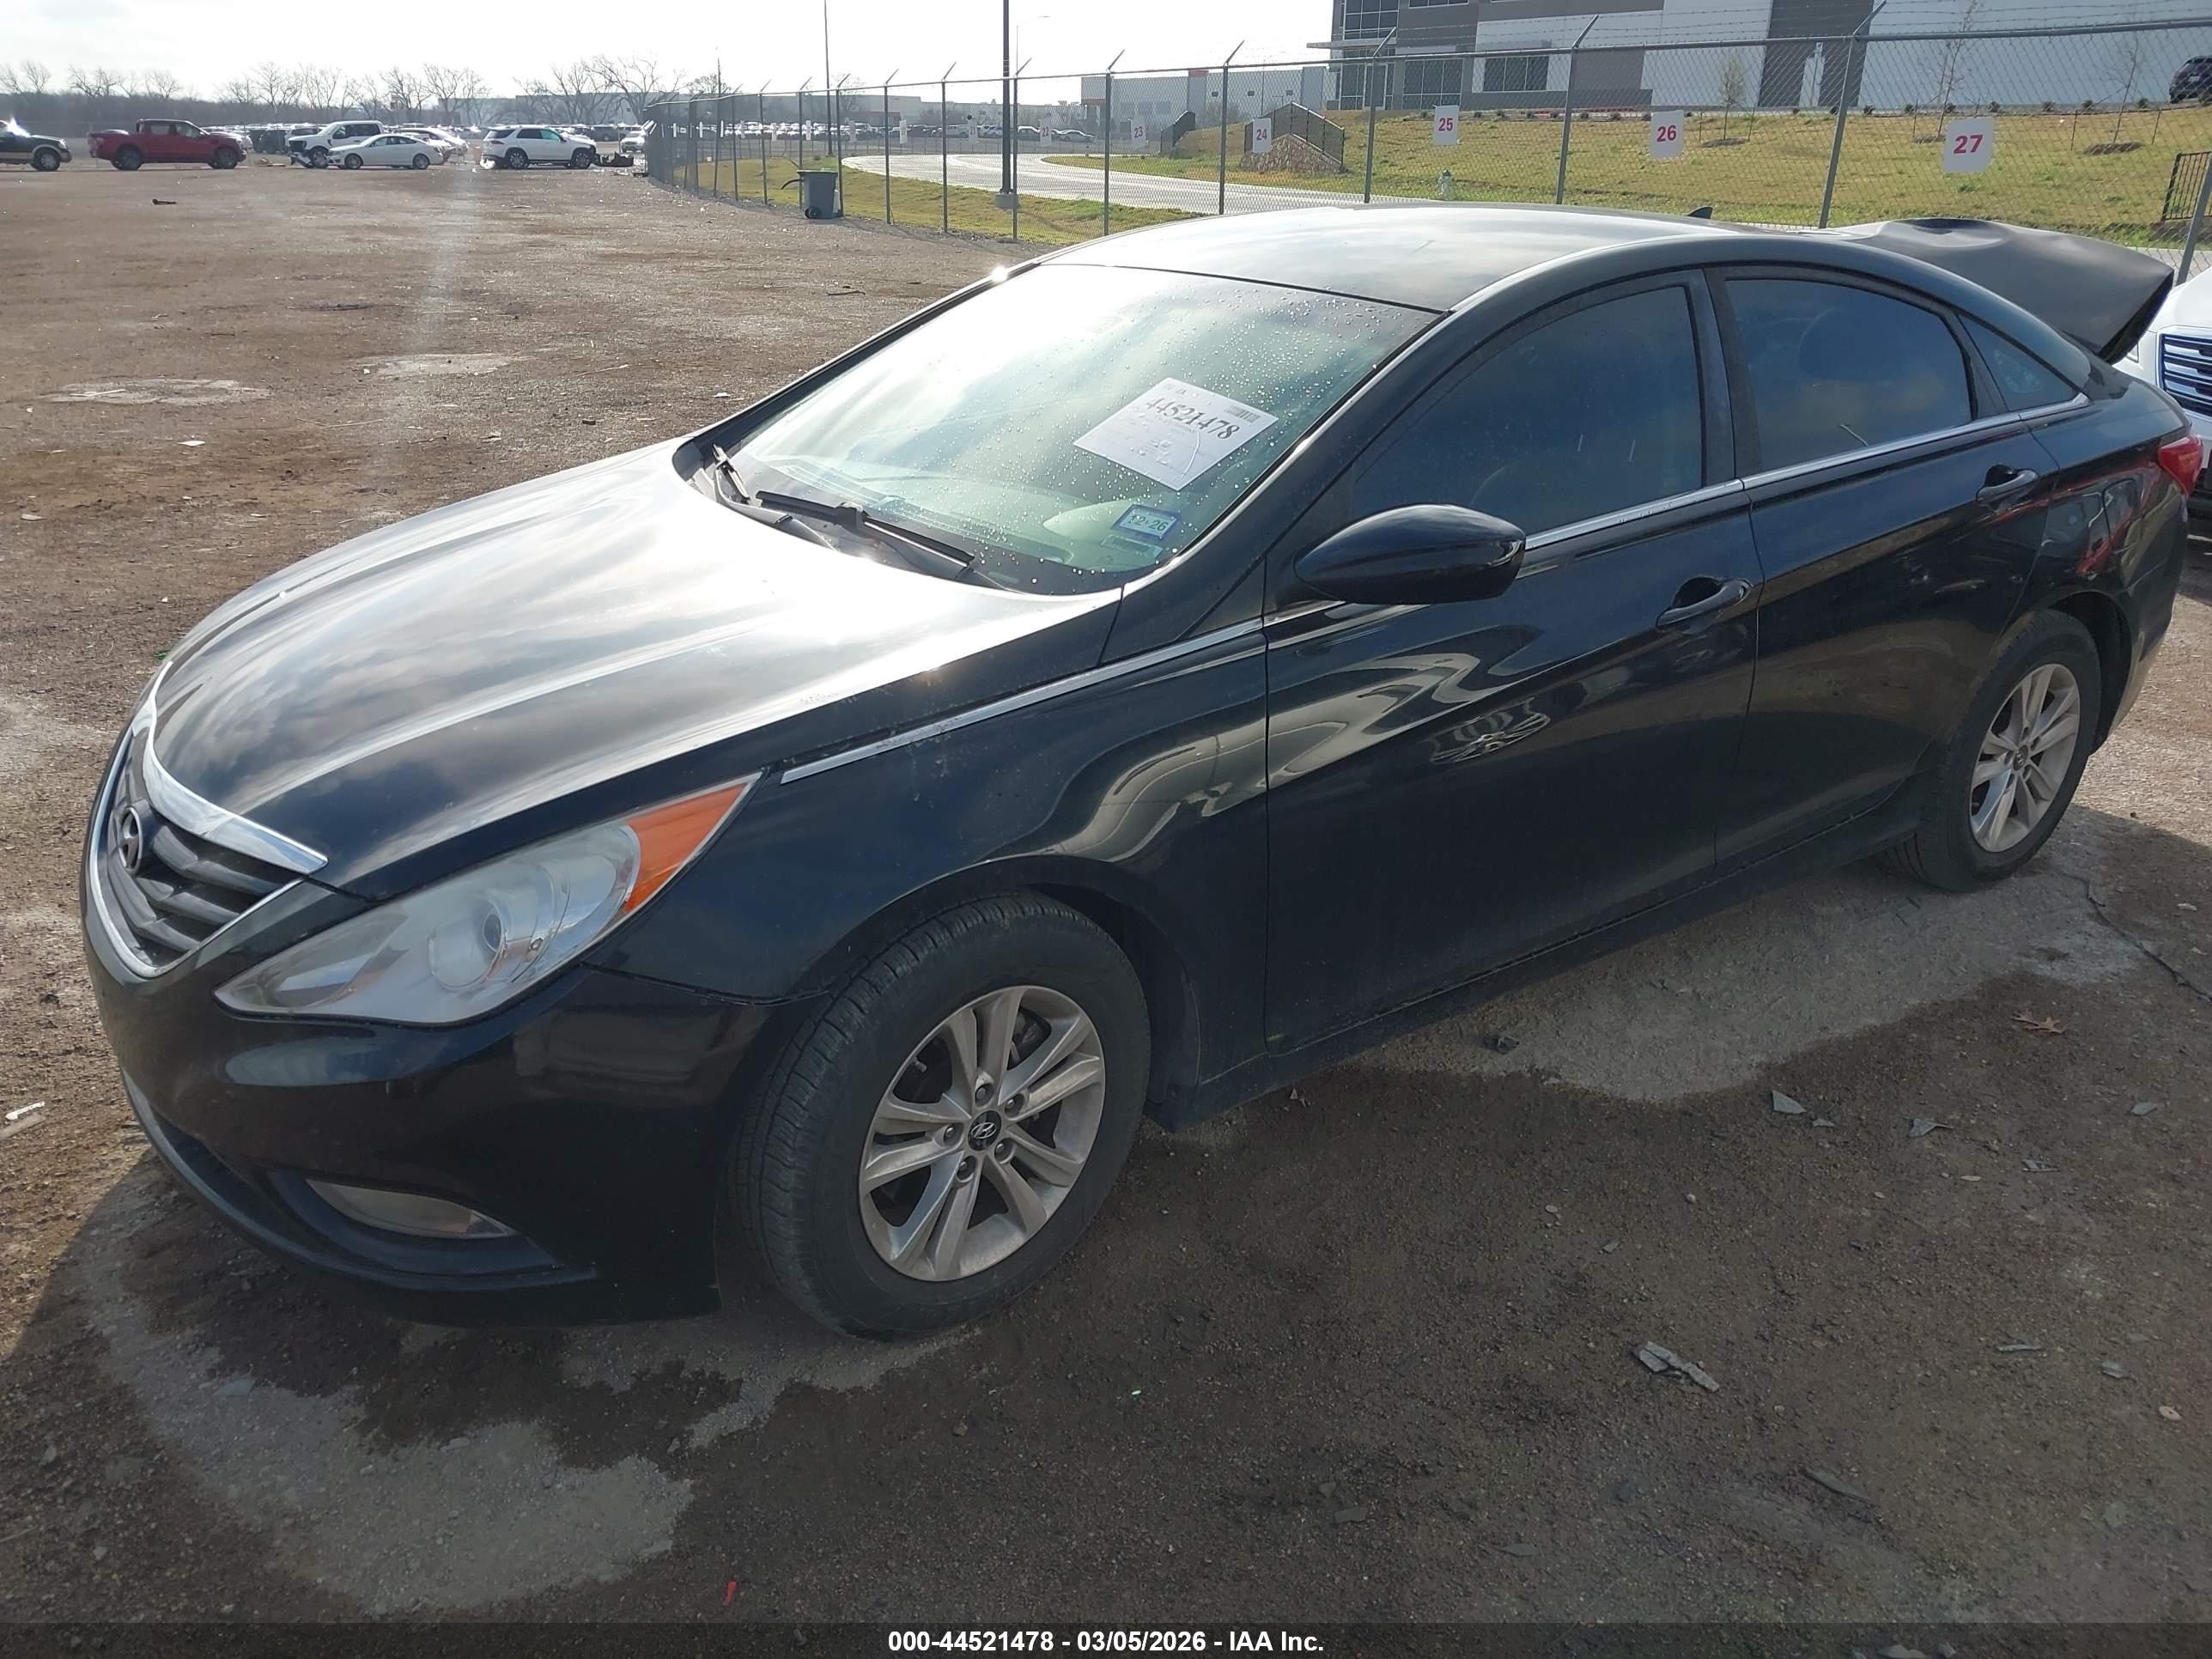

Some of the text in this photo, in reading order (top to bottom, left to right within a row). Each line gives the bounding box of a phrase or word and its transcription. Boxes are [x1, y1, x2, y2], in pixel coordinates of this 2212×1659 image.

[1133, 126, 1144, 138] 23
[1437, 118, 1453, 131] 25
[1256, 129, 1267, 141] 24
[1656, 125, 1677, 143] 26
[1953, 134, 1984, 155] 27
[1146, 398, 1240, 440] 44521478
